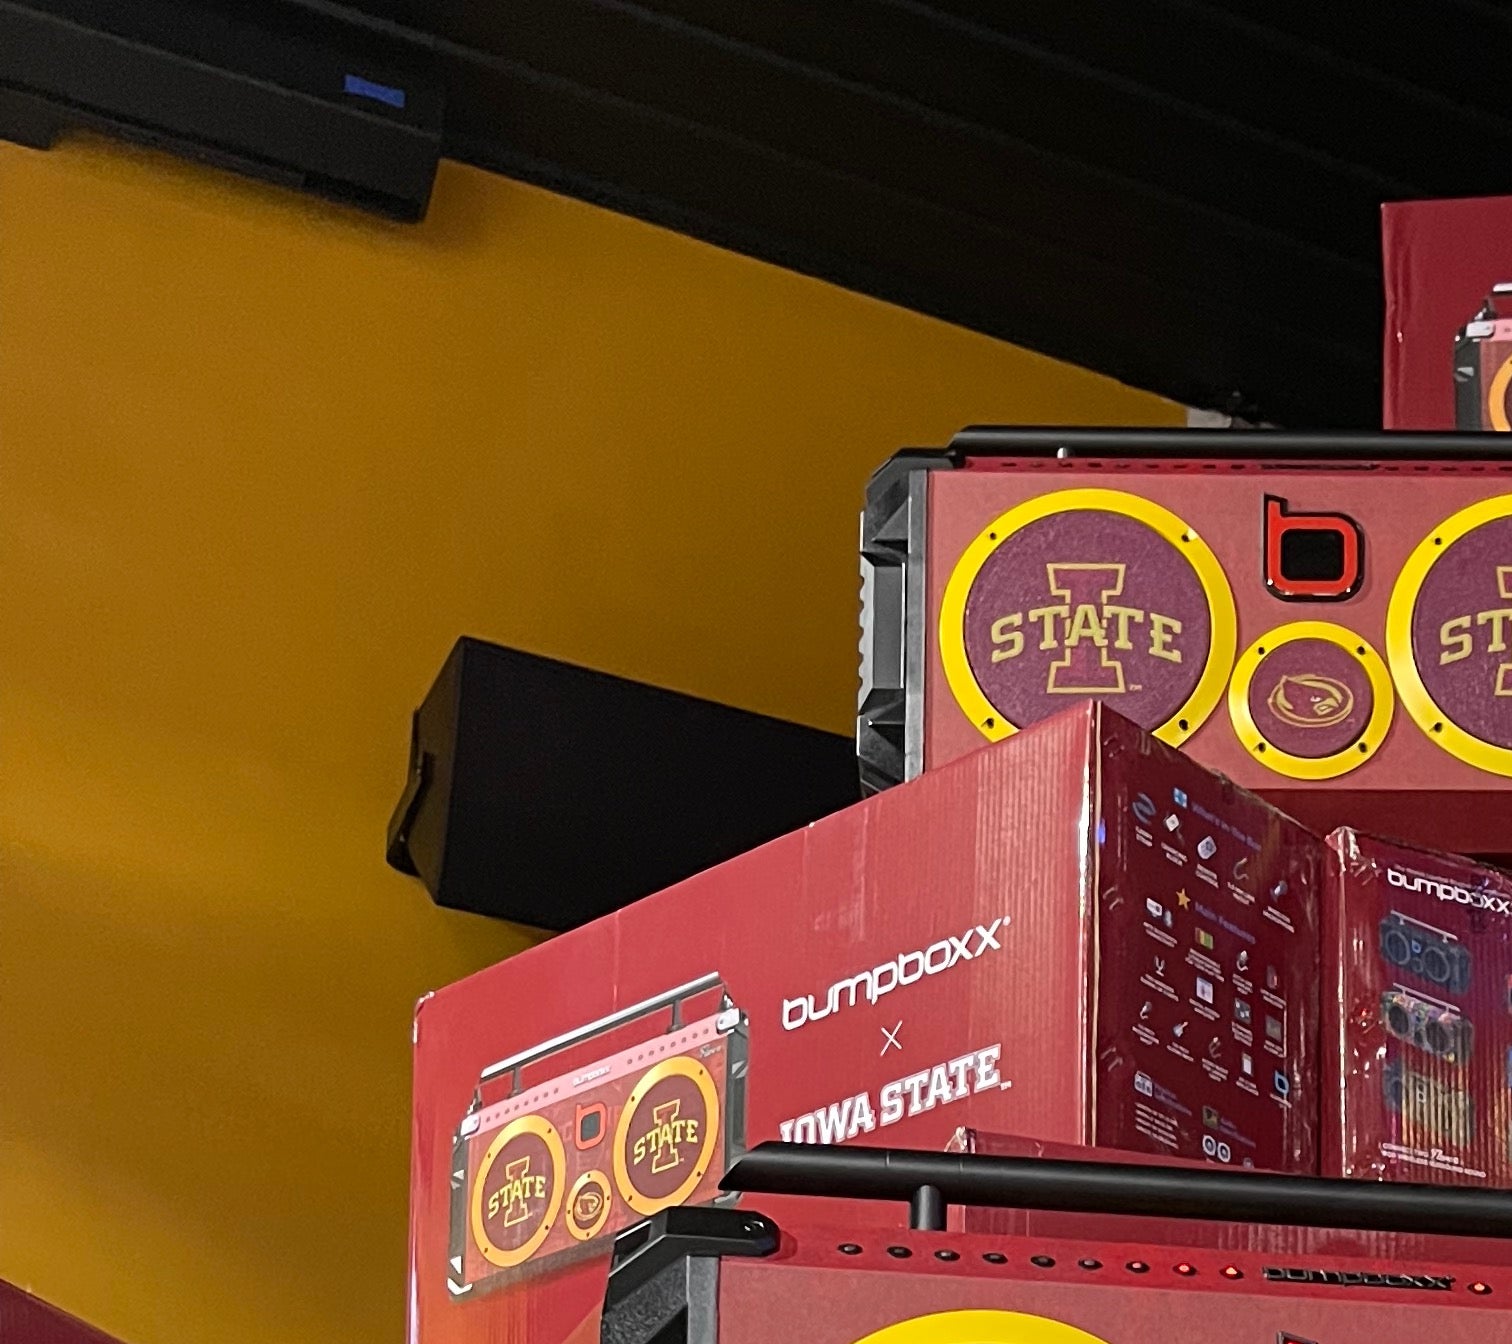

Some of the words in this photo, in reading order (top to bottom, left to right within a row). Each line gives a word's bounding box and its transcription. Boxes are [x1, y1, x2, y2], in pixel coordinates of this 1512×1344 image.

[990, 605, 1184, 665] STATE
[782, 917, 1005, 1030] bumpboxx
[880, 1043, 1001, 1126] STATE
[634, 1120, 699, 1165] STATE
[488, 1175, 546, 1219] STATE
